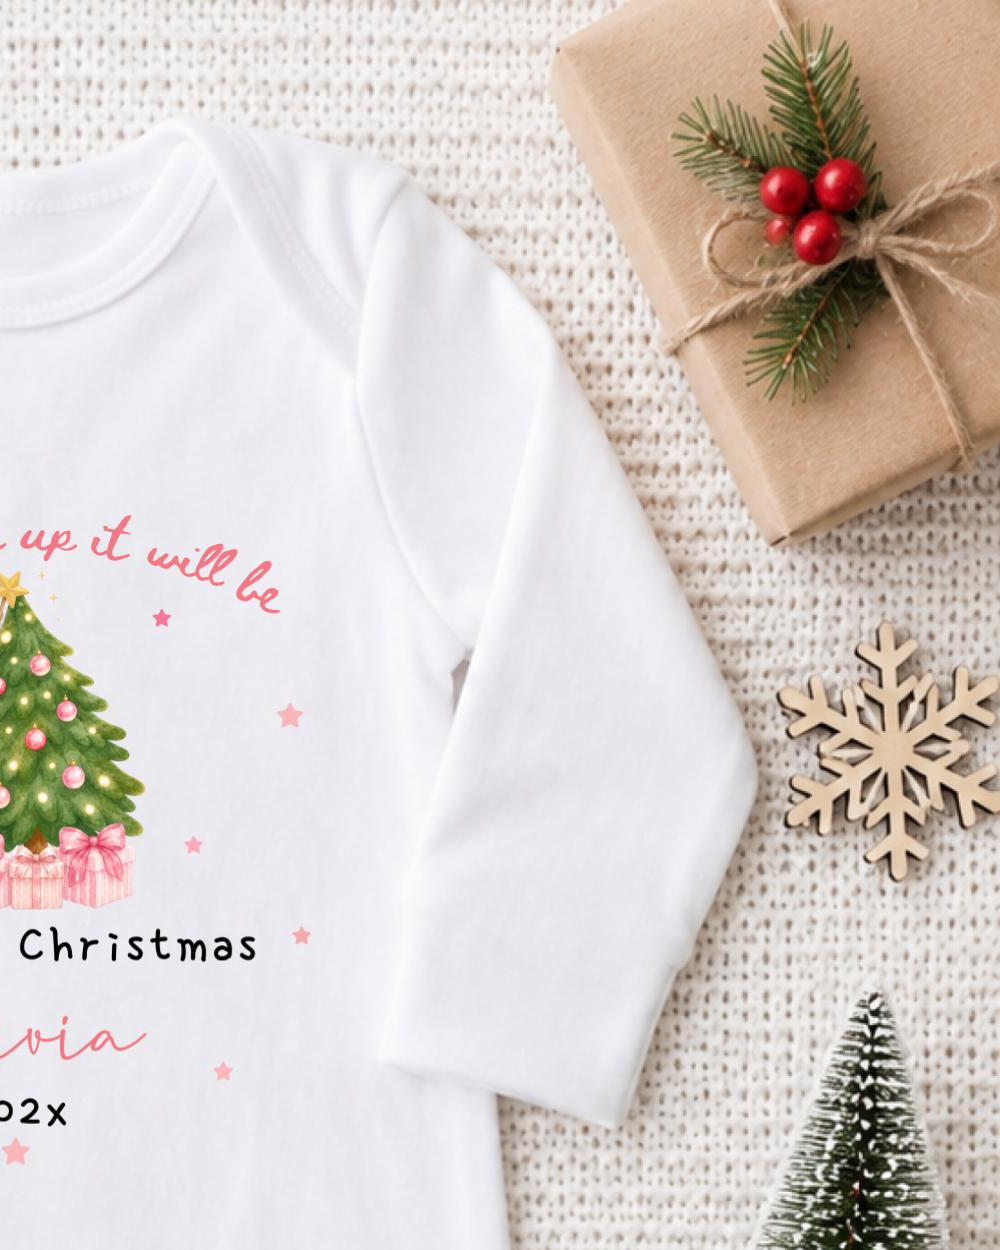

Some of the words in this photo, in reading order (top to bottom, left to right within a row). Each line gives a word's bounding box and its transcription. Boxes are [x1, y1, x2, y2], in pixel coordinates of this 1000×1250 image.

[20, 523, 78, 561] up
[90, 514, 132, 562] it
[147, 541, 238, 587] will
[235, 560, 281, 615] be
[19, 926, 257, 963] Christmas
